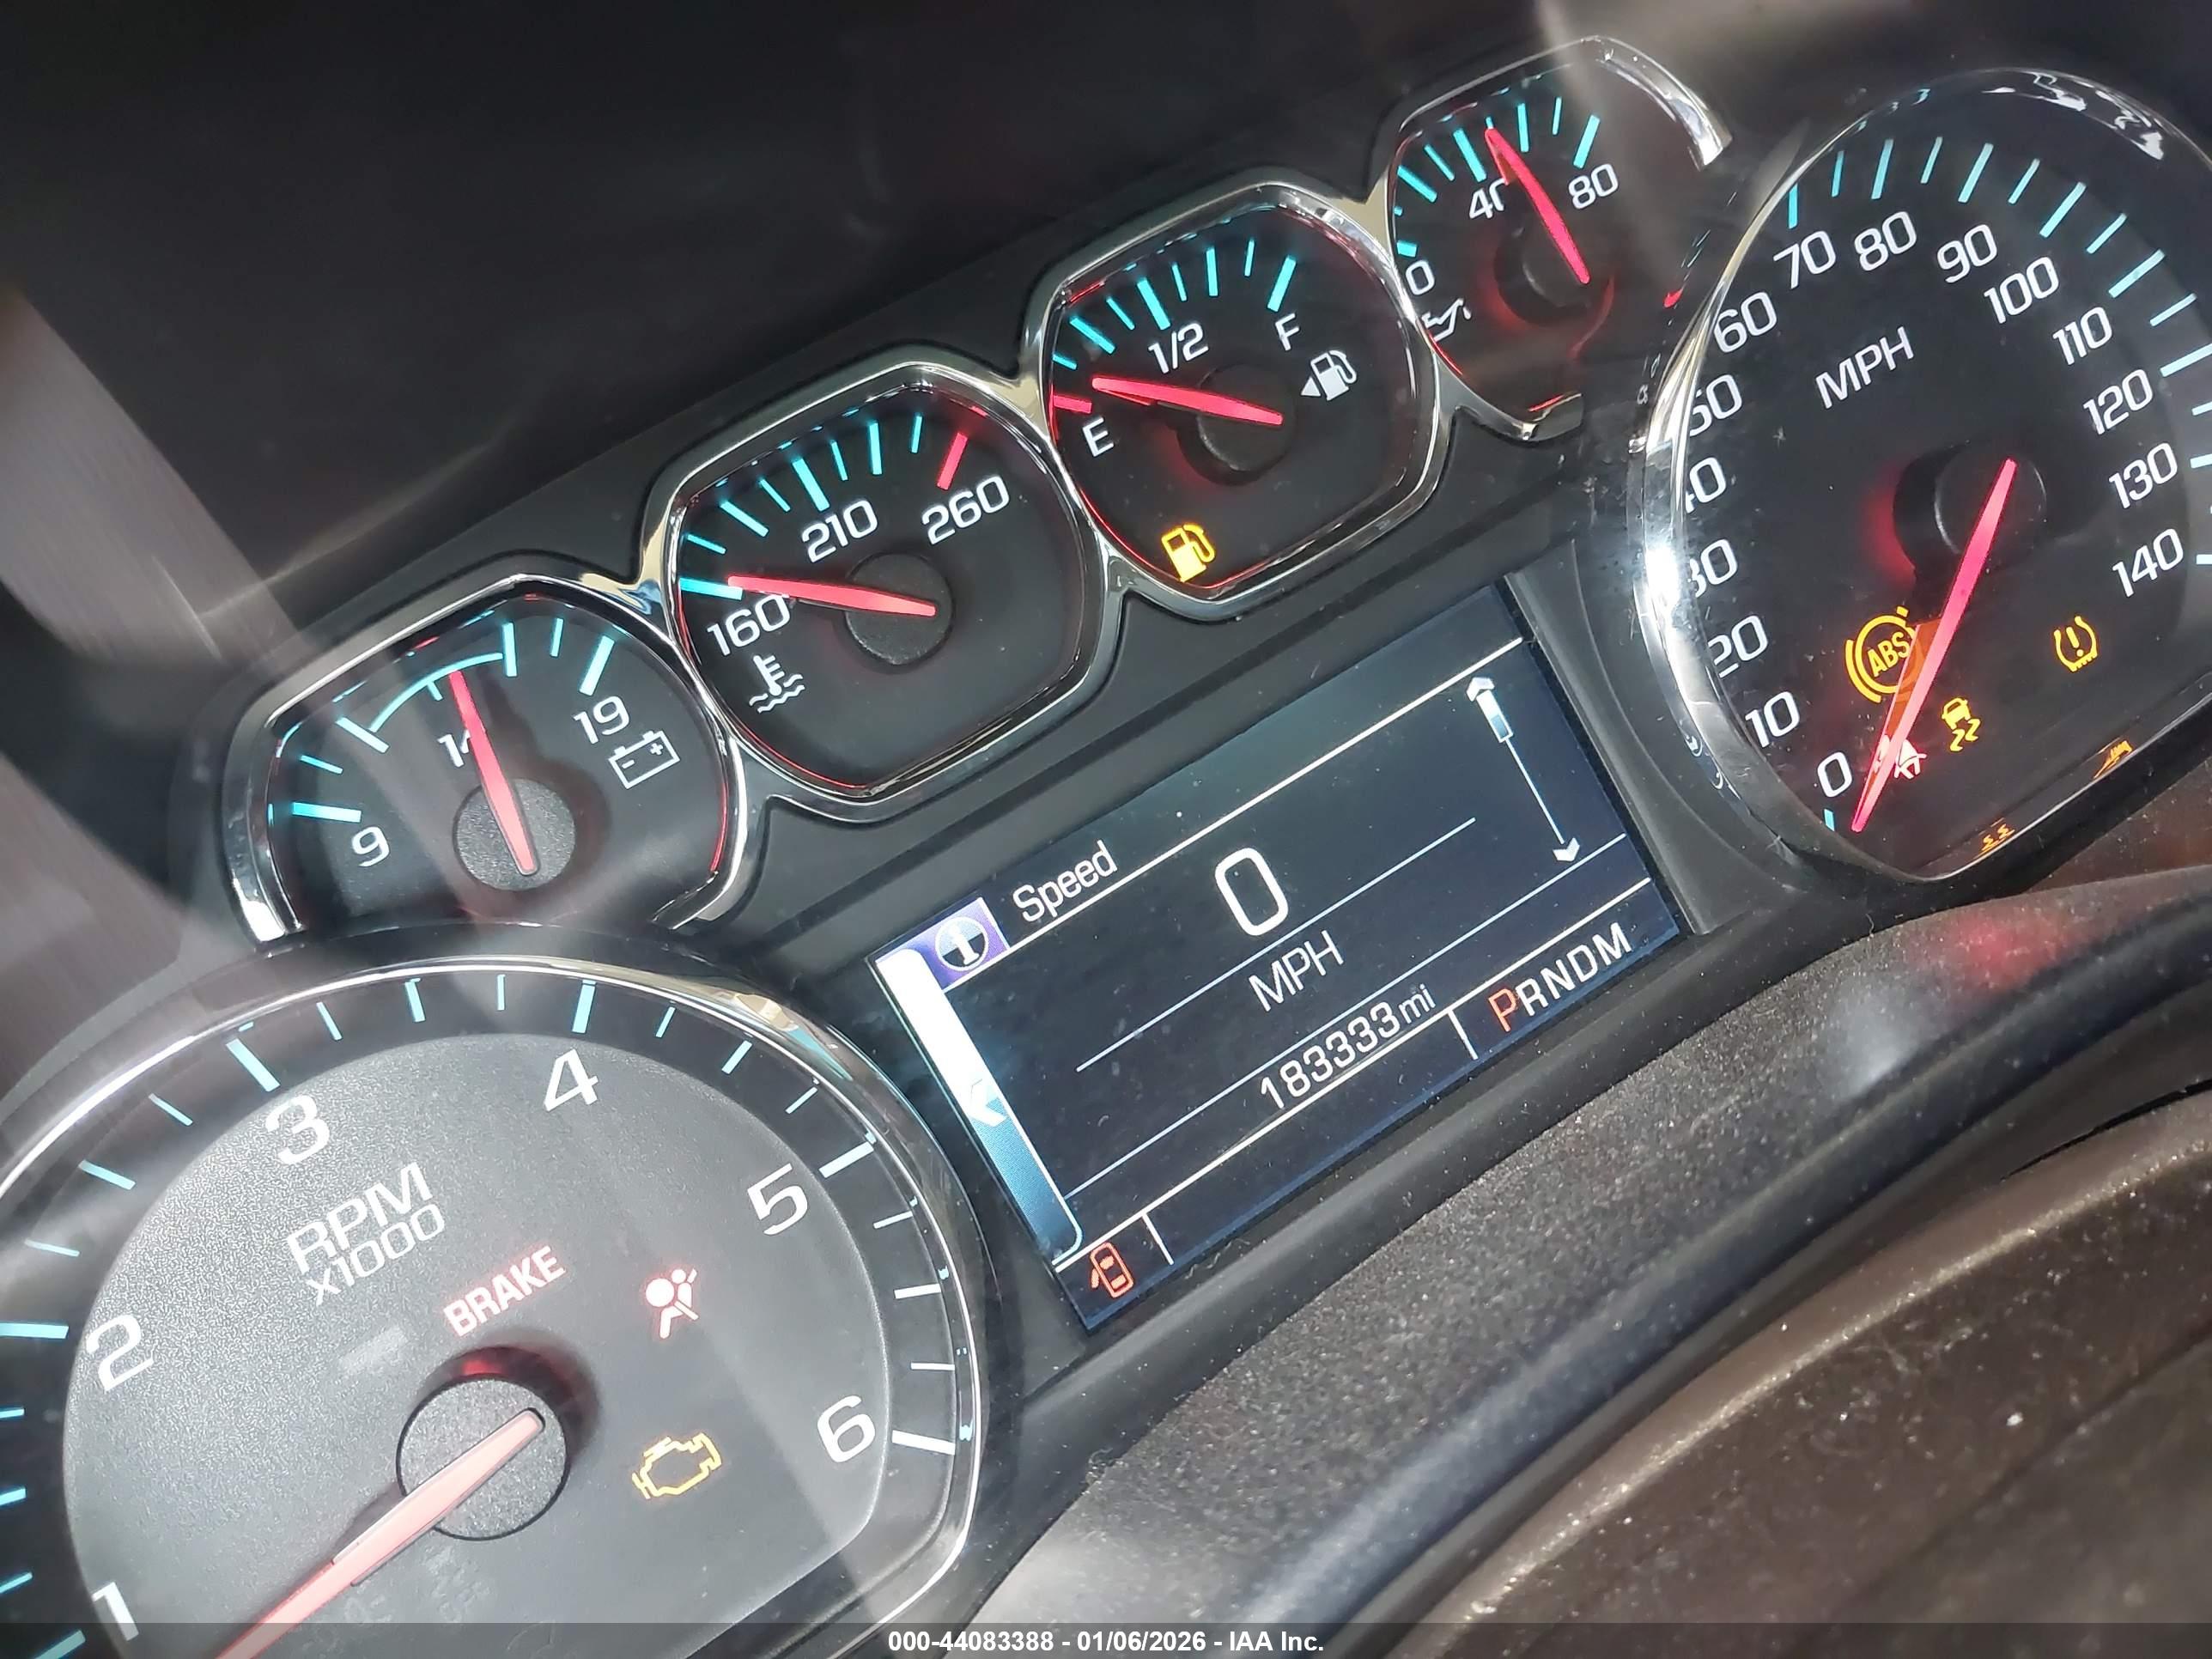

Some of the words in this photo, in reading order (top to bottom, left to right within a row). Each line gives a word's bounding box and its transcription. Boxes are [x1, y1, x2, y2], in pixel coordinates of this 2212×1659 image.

[1569, 164, 1619, 210] 80
[1772, 230, 1837, 289] 70
[1854, 211, 1917, 272] 80
[1936, 224, 1998, 283] 90
[1405, 260, 1435, 295] 0
[1984, 256, 2060, 324] 100
[1148, 322, 1208, 374] 1/2
[1274, 313, 1300, 350] F
[1713, 292, 1778, 353] 60
[2052, 307, 2113, 365] 110
[1814, 326, 1915, 410] MPH
[2083, 368, 2154, 434] 120
[1082, 416, 1114, 457] E
[2108, 442, 2179, 508] 130
[801, 500, 878, 562] 210
[921, 475, 1010, 544] 260
[2112, 528, 2185, 597] 140
[707, 592, 791, 656] 160
[1707, 615, 1769, 678] 20
[1866, 630, 1911, 678] ABS
[573, 696, 630, 744] 19
[1744, 690, 1801, 748] 10
[1817, 751, 1853, 798] 0
[350, 826, 390, 867] 9
[1012, 839, 1118, 923] Speed
[1214, 847, 1290, 937] 0
[1248, 930, 1345, 1012] MPH
[544, 1048, 599, 1113] 4
[265, 1094, 331, 1166] 3
[285, 1161, 434, 1274] RPM
[747, 1163, 809, 1236] 5
[306, 1203, 447, 1306] x1000
[443, 1244, 568, 1337] BRAKE
[85, 1313, 154, 1392] 2
[817, 1395, 877, 1463] 6
[91, 1581, 139, 1642] 1
